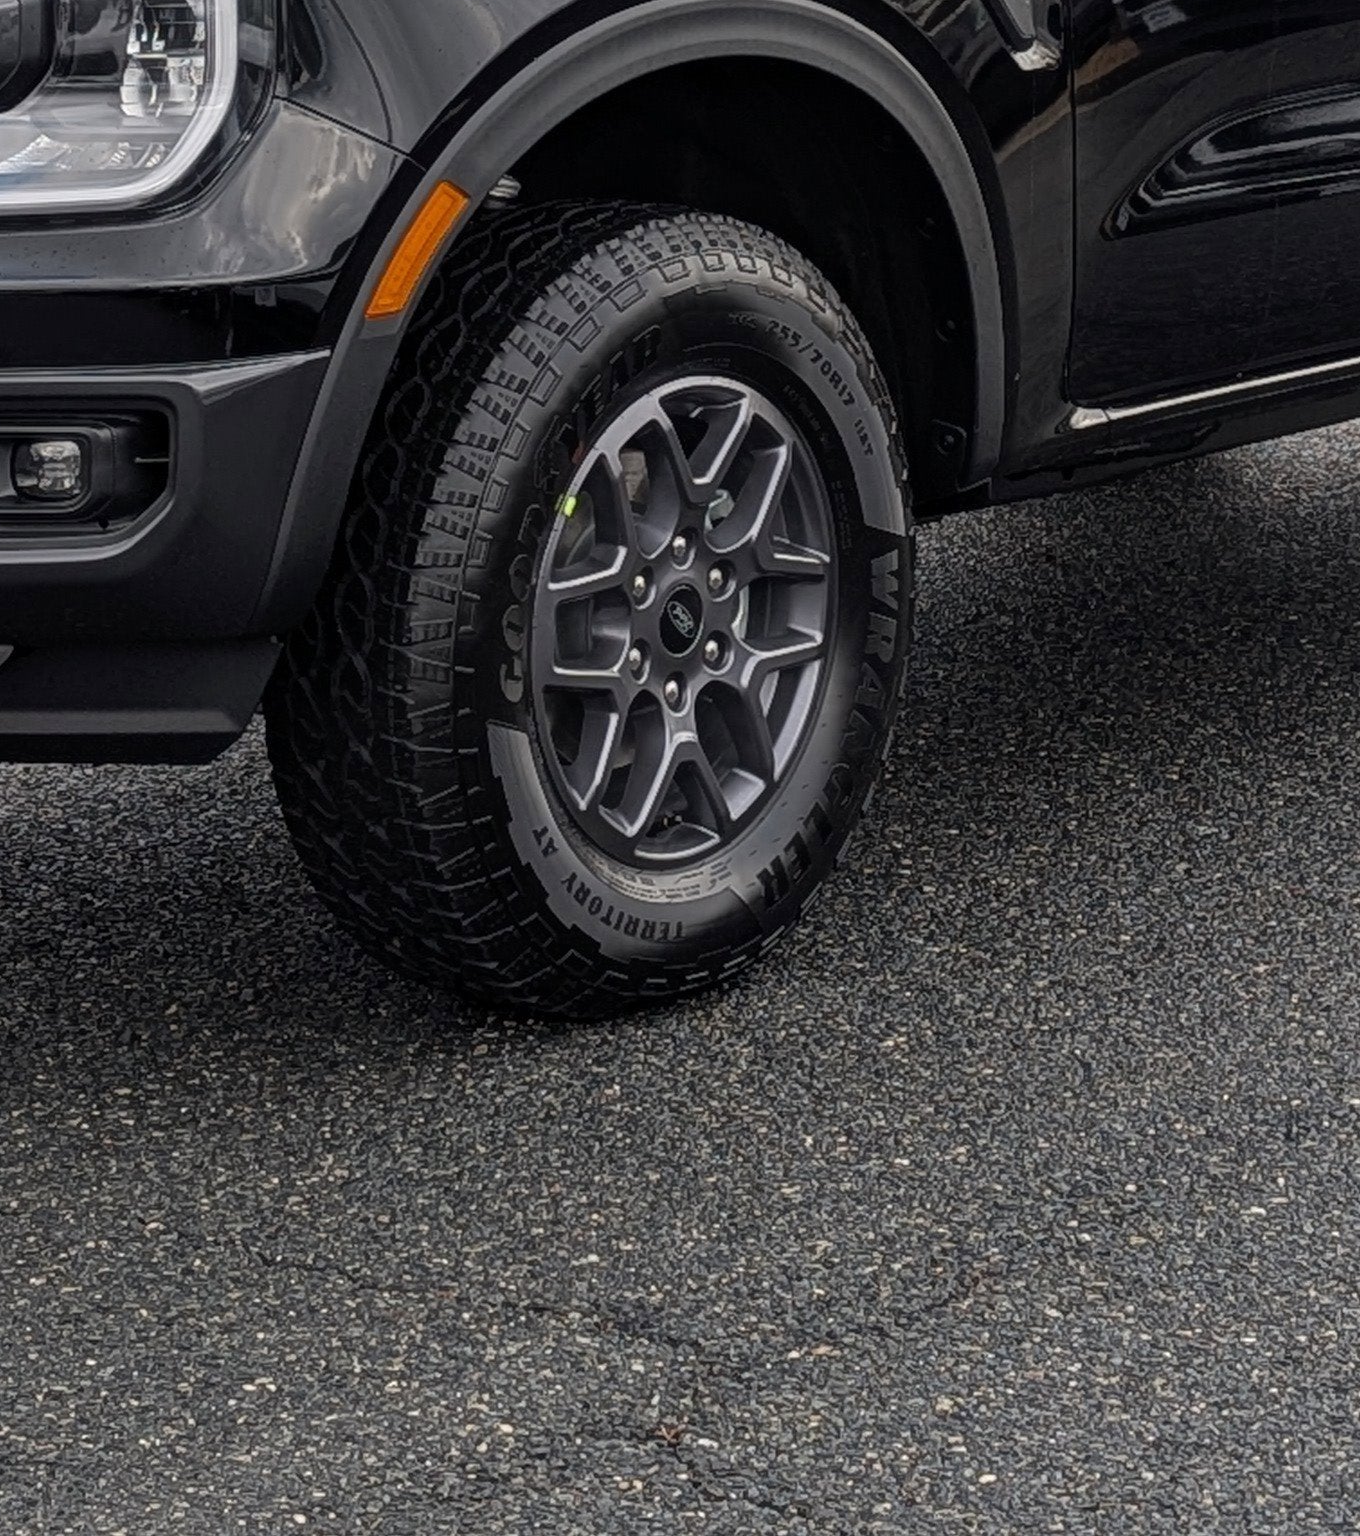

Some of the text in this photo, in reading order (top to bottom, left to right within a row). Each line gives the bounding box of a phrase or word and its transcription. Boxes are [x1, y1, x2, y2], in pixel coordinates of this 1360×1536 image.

[765, 319, 856, 406] 255/70R17
[754, 547, 901, 907] WRANGLER
[530, 825, 559, 858] AT
[560, 871, 688, 942] TERRITORY
